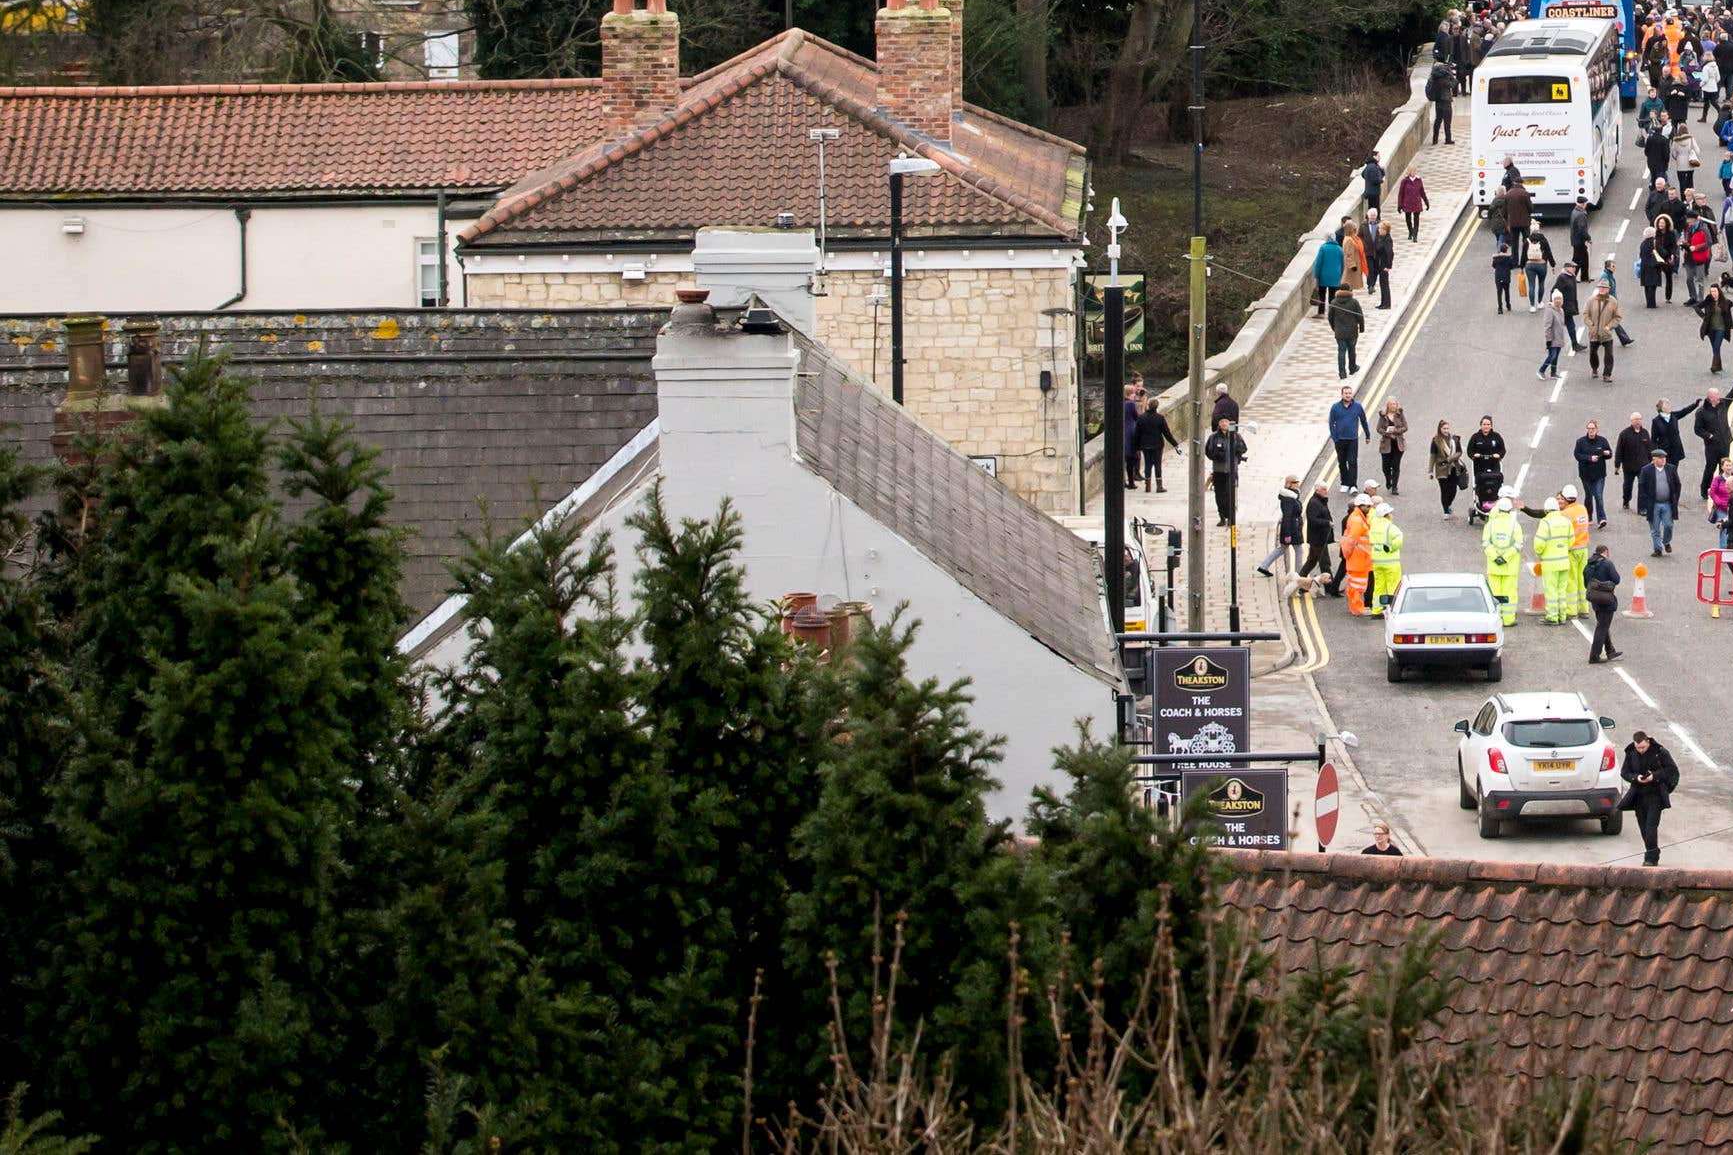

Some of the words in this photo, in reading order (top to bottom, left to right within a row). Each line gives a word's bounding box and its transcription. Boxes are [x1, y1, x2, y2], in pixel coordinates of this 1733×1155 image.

[1547, 7, 1615, 18] COASTLINER
[1491, 124, 1521, 142] Just
[1526, 124, 1570, 138] Travel
[1177, 675, 1225, 685] THEAKSTON
[1192, 696, 1211, 705] THE
[1160, 708, 1192, 717] COACH
[1195, 708, 1202, 717] &
[1204, 707, 1242, 717] HORSES
[1225, 823, 1246, 833] THE
[1228, 836, 1237, 845] &
[1238, 835, 1281, 845] HORSES
